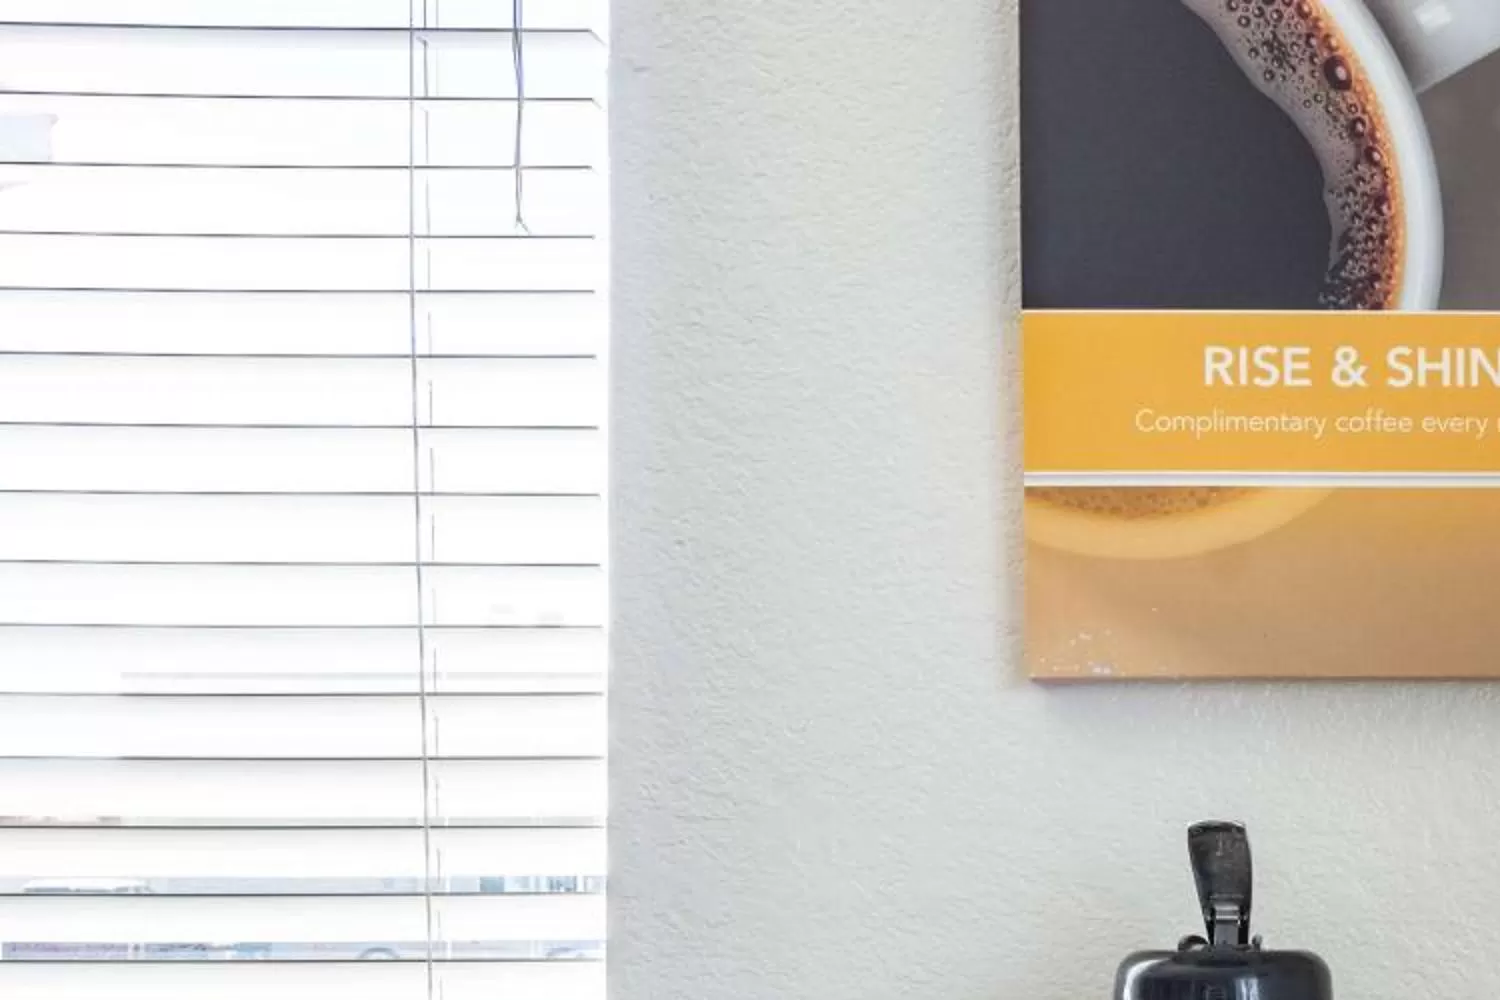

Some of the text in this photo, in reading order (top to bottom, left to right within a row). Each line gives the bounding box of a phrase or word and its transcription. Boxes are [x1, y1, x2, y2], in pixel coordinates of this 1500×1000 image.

[1203, 345, 1313, 388] RISE
[1330, 345, 1369, 388] &
[1134, 407, 1327, 440] Complimentary
[1335, 410, 1413, 434] coffee
[1421, 416, 1489, 440] every
